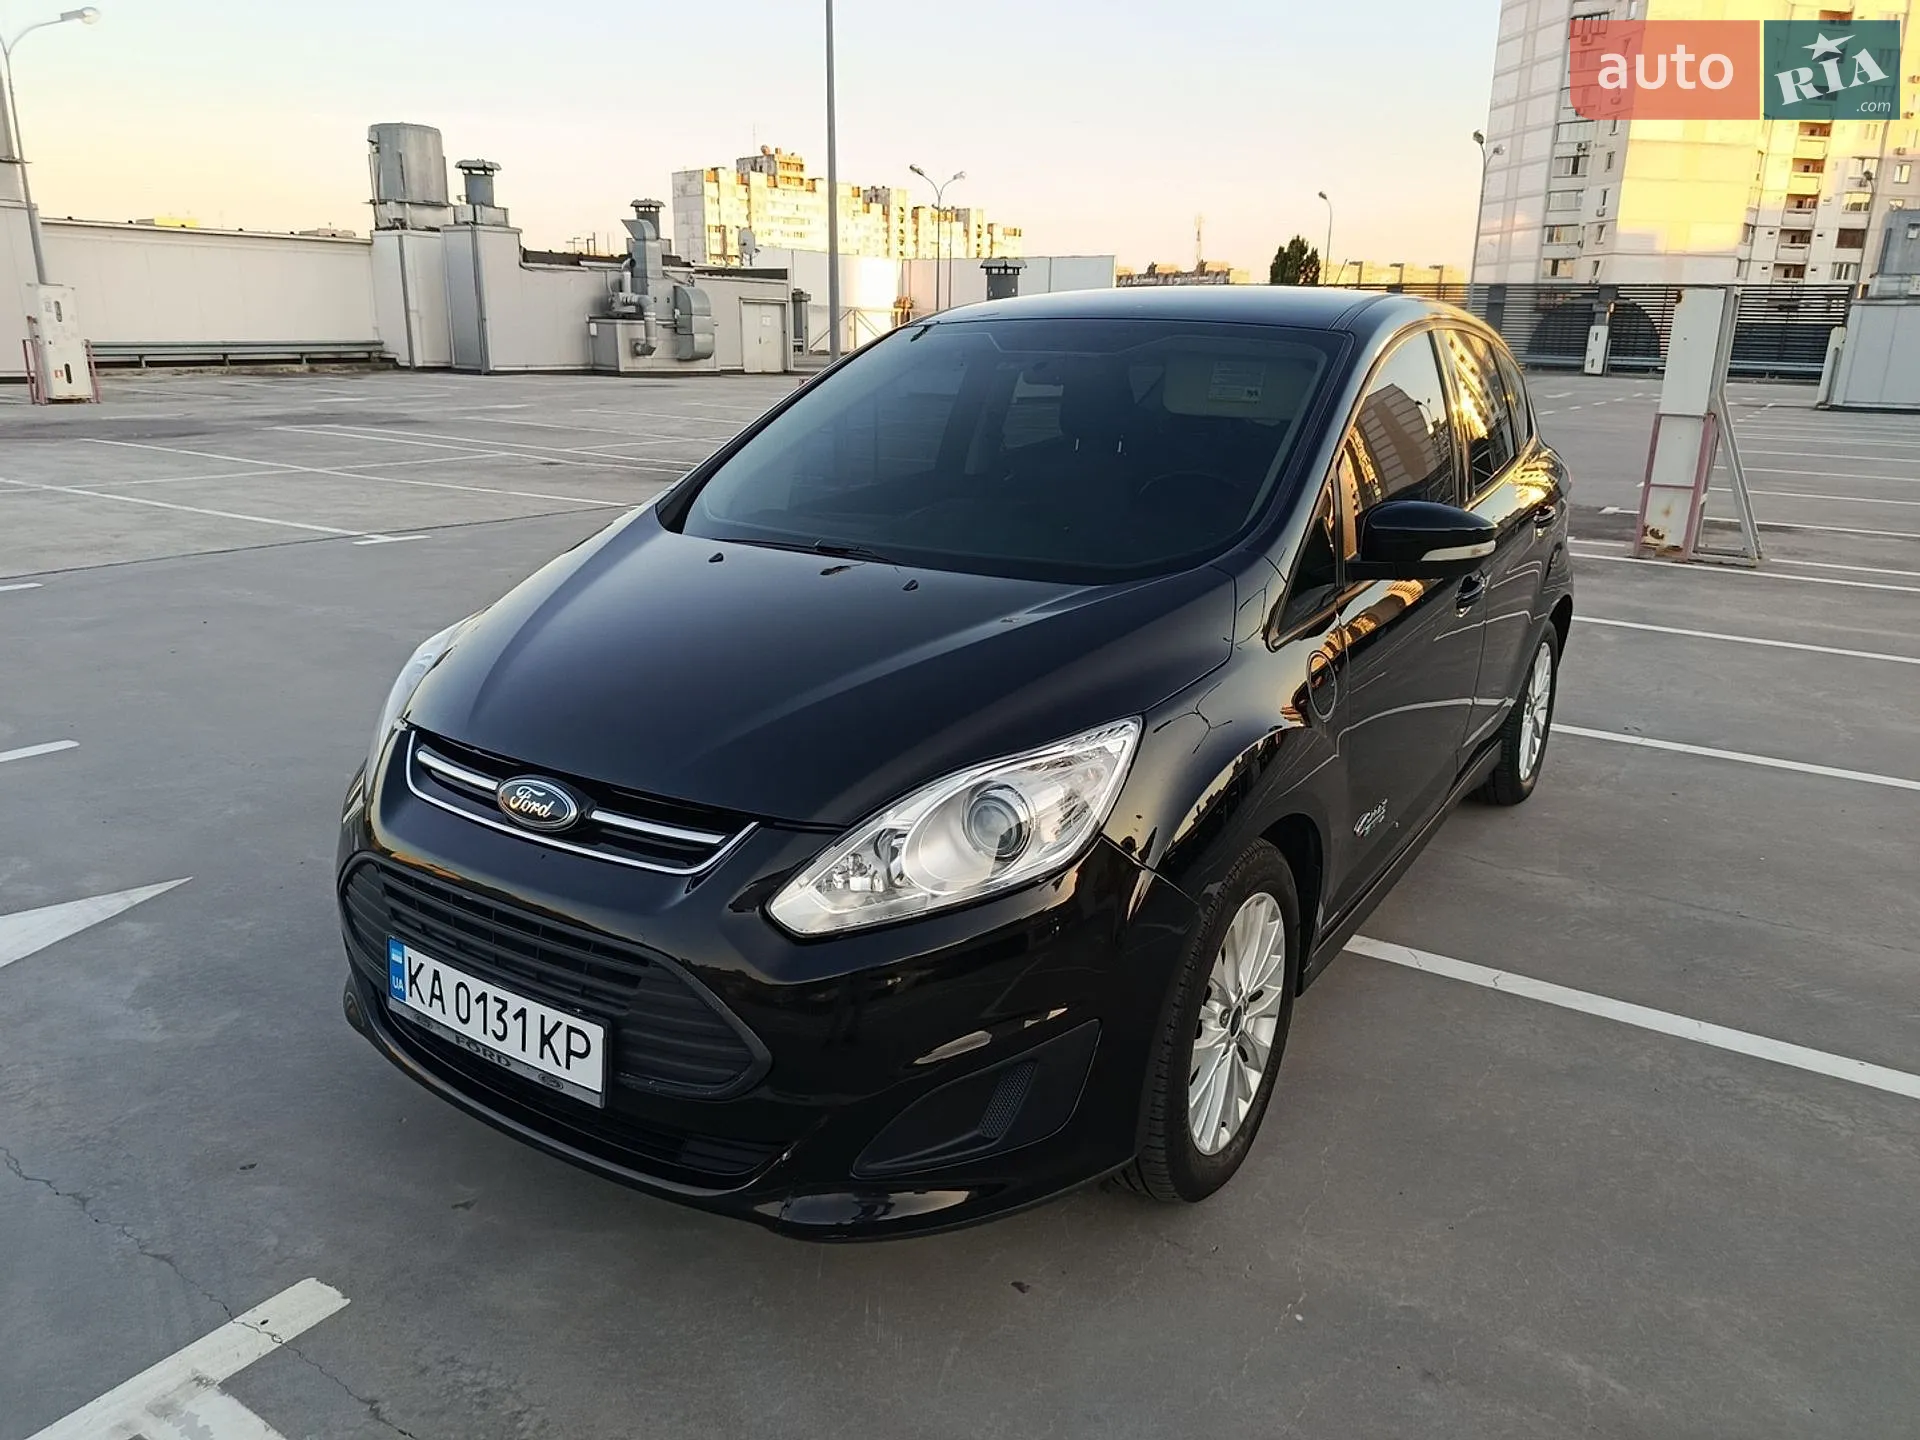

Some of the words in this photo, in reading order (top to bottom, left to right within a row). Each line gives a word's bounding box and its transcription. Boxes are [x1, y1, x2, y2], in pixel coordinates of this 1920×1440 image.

[509, 785, 556, 818] Ford
[391, 974, 404, 992] UA
[407, 955, 446, 1015] KA
[455, 981, 528, 1053] 0131
[538, 1013, 592, 1071] KP
[455, 1033, 512, 1067] FORD
